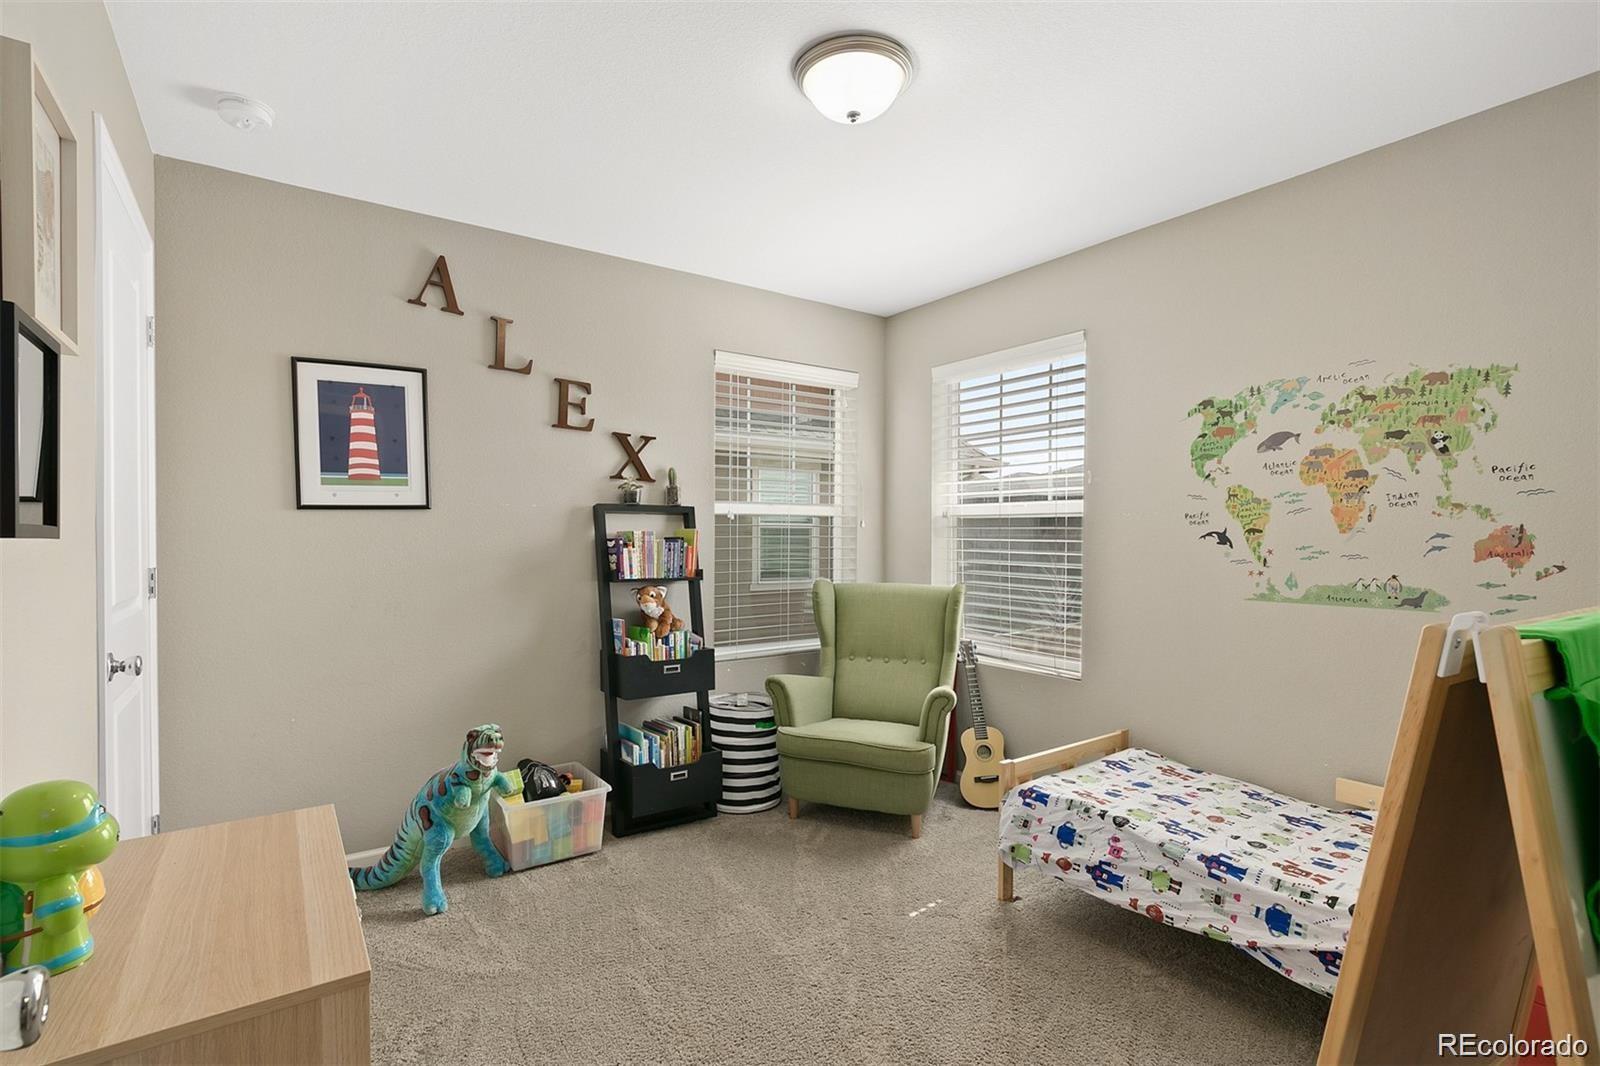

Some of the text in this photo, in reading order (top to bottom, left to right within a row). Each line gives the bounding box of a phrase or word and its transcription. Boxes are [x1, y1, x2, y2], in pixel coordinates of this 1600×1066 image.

[407, 255, 656, 483] ALEX
[1342, 374, 1370, 384] ocean
[1491, 462, 1536, 474] Pacific
[1499, 473, 1534, 482] ocean
[1386, 492, 1420, 502] Indian
[1388, 500, 1418, 508] ocean
